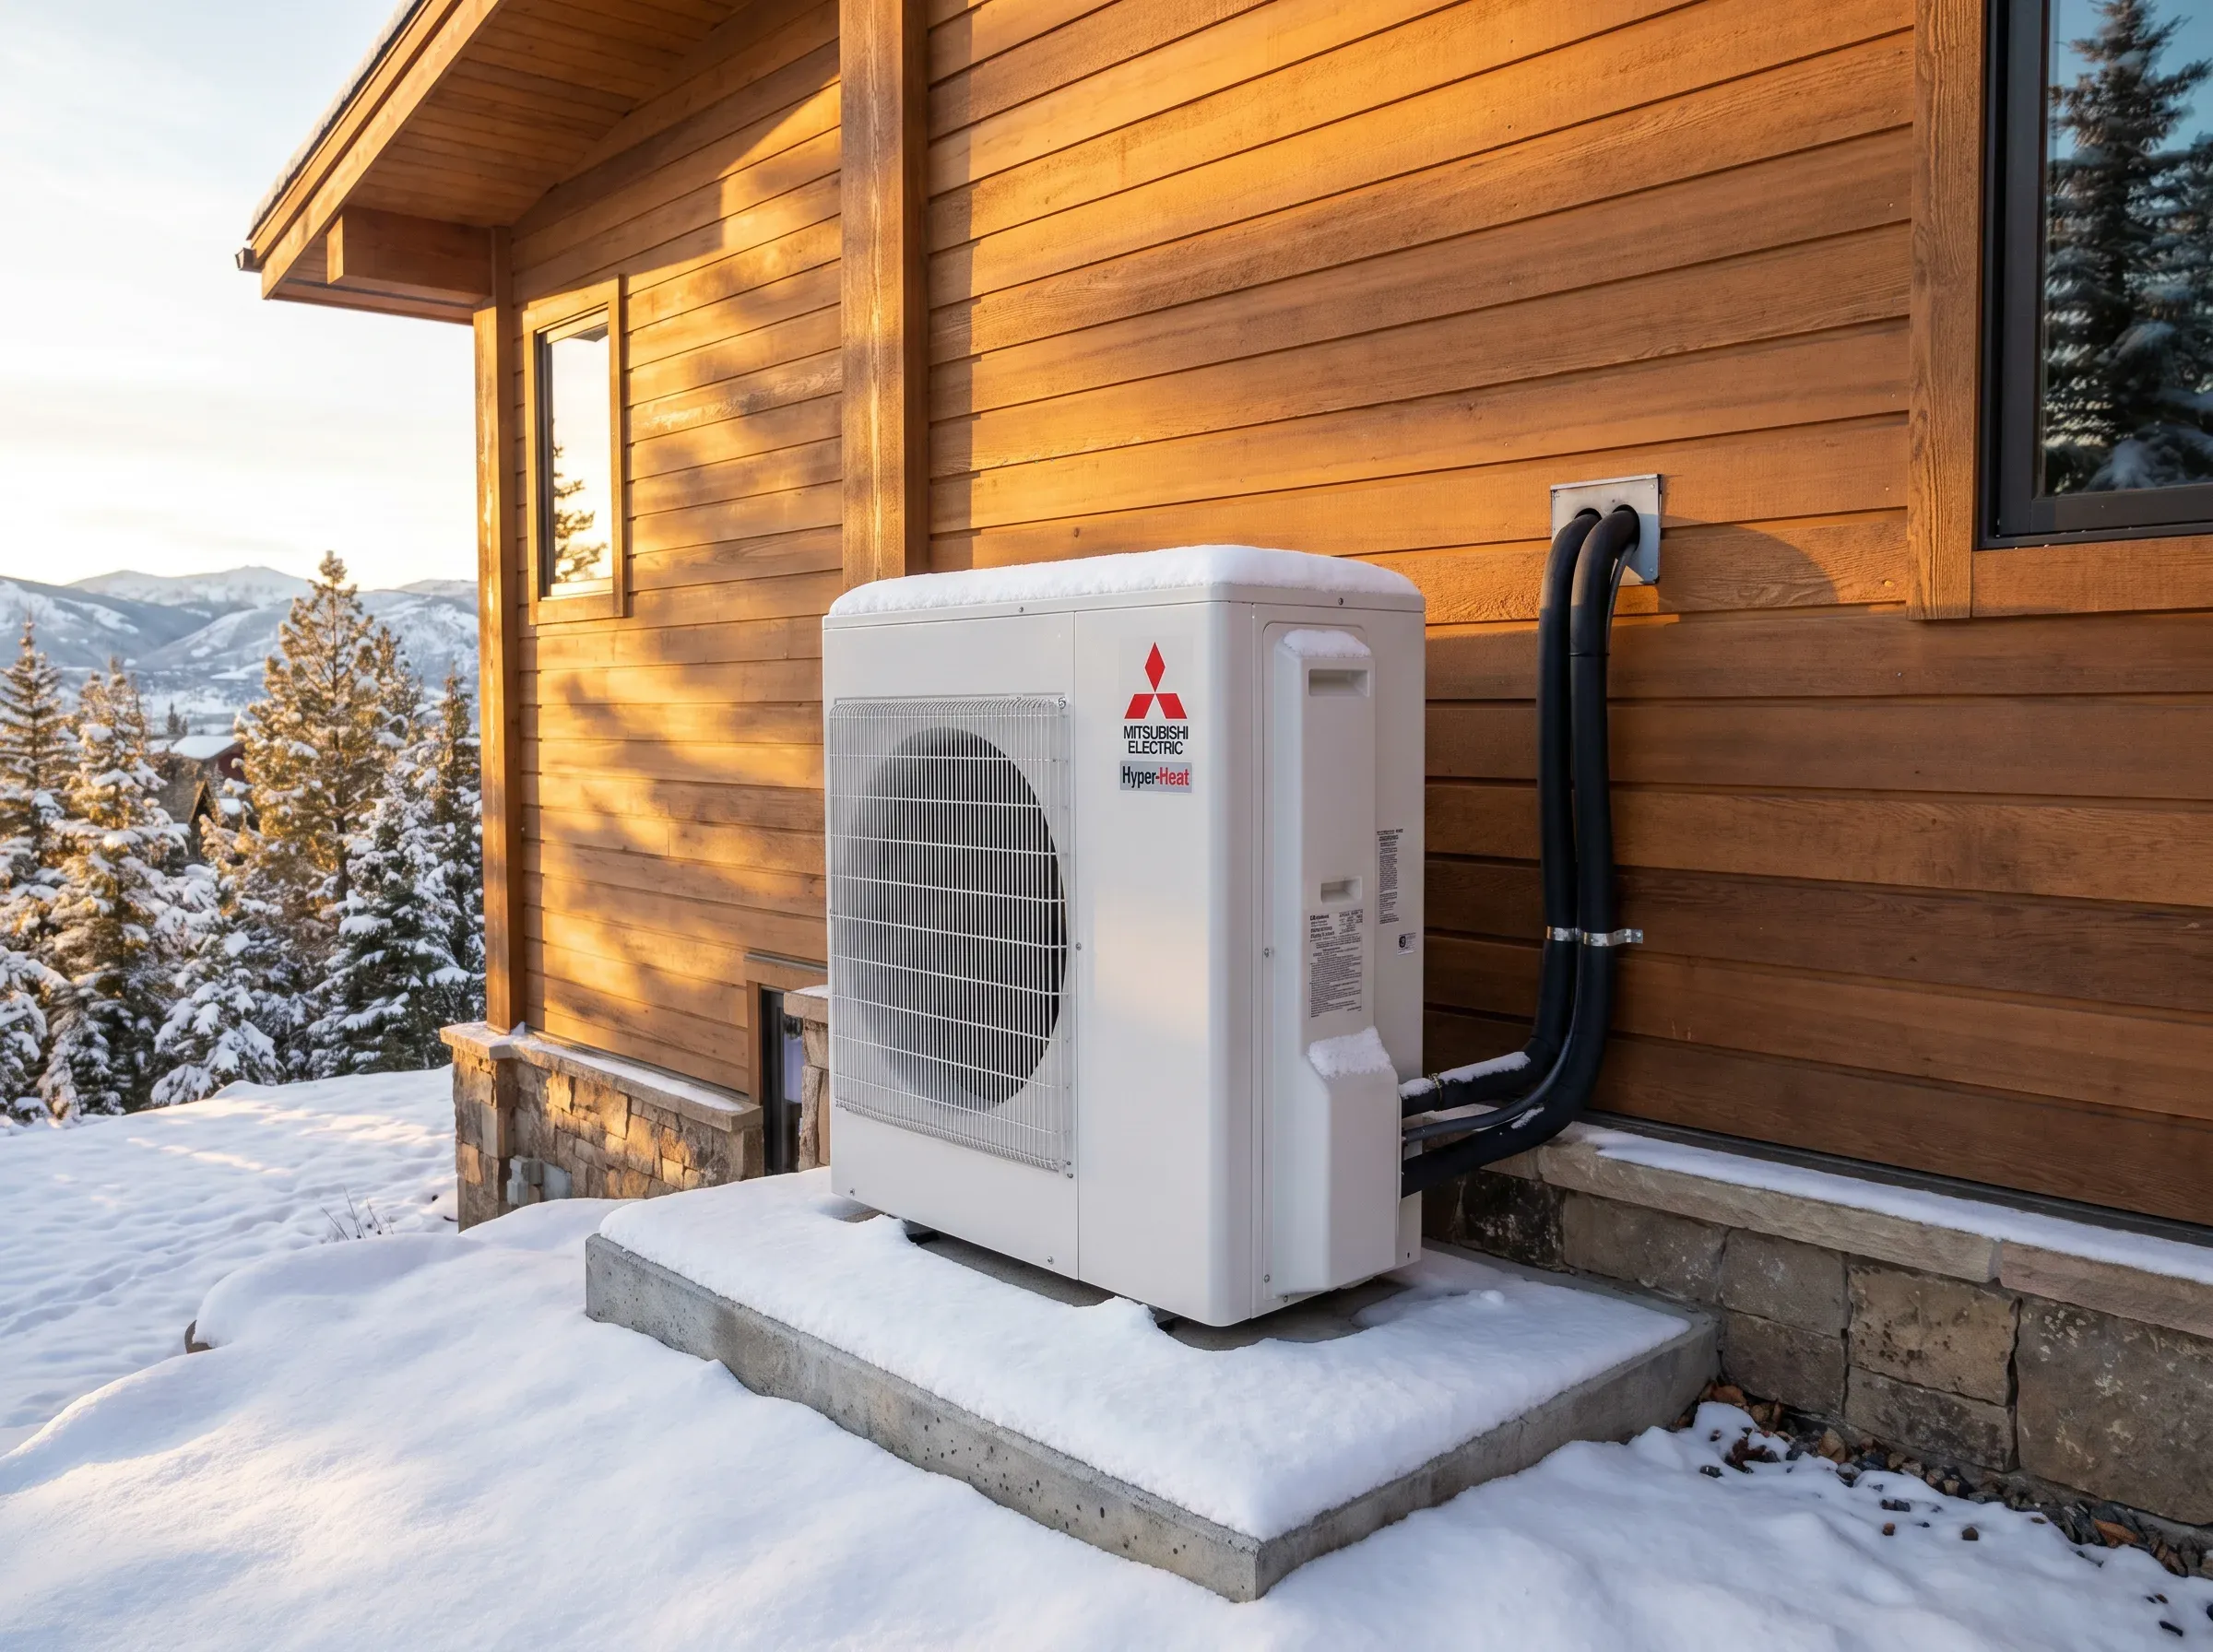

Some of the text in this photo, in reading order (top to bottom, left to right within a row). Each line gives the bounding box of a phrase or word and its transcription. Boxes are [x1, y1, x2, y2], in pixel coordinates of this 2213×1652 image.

[1123, 726, 1189, 740] MITSUBISHI
[1128, 740, 1184, 755] ELECTRIC
[1122, 765, 1189, 789] Hyper-Heat
